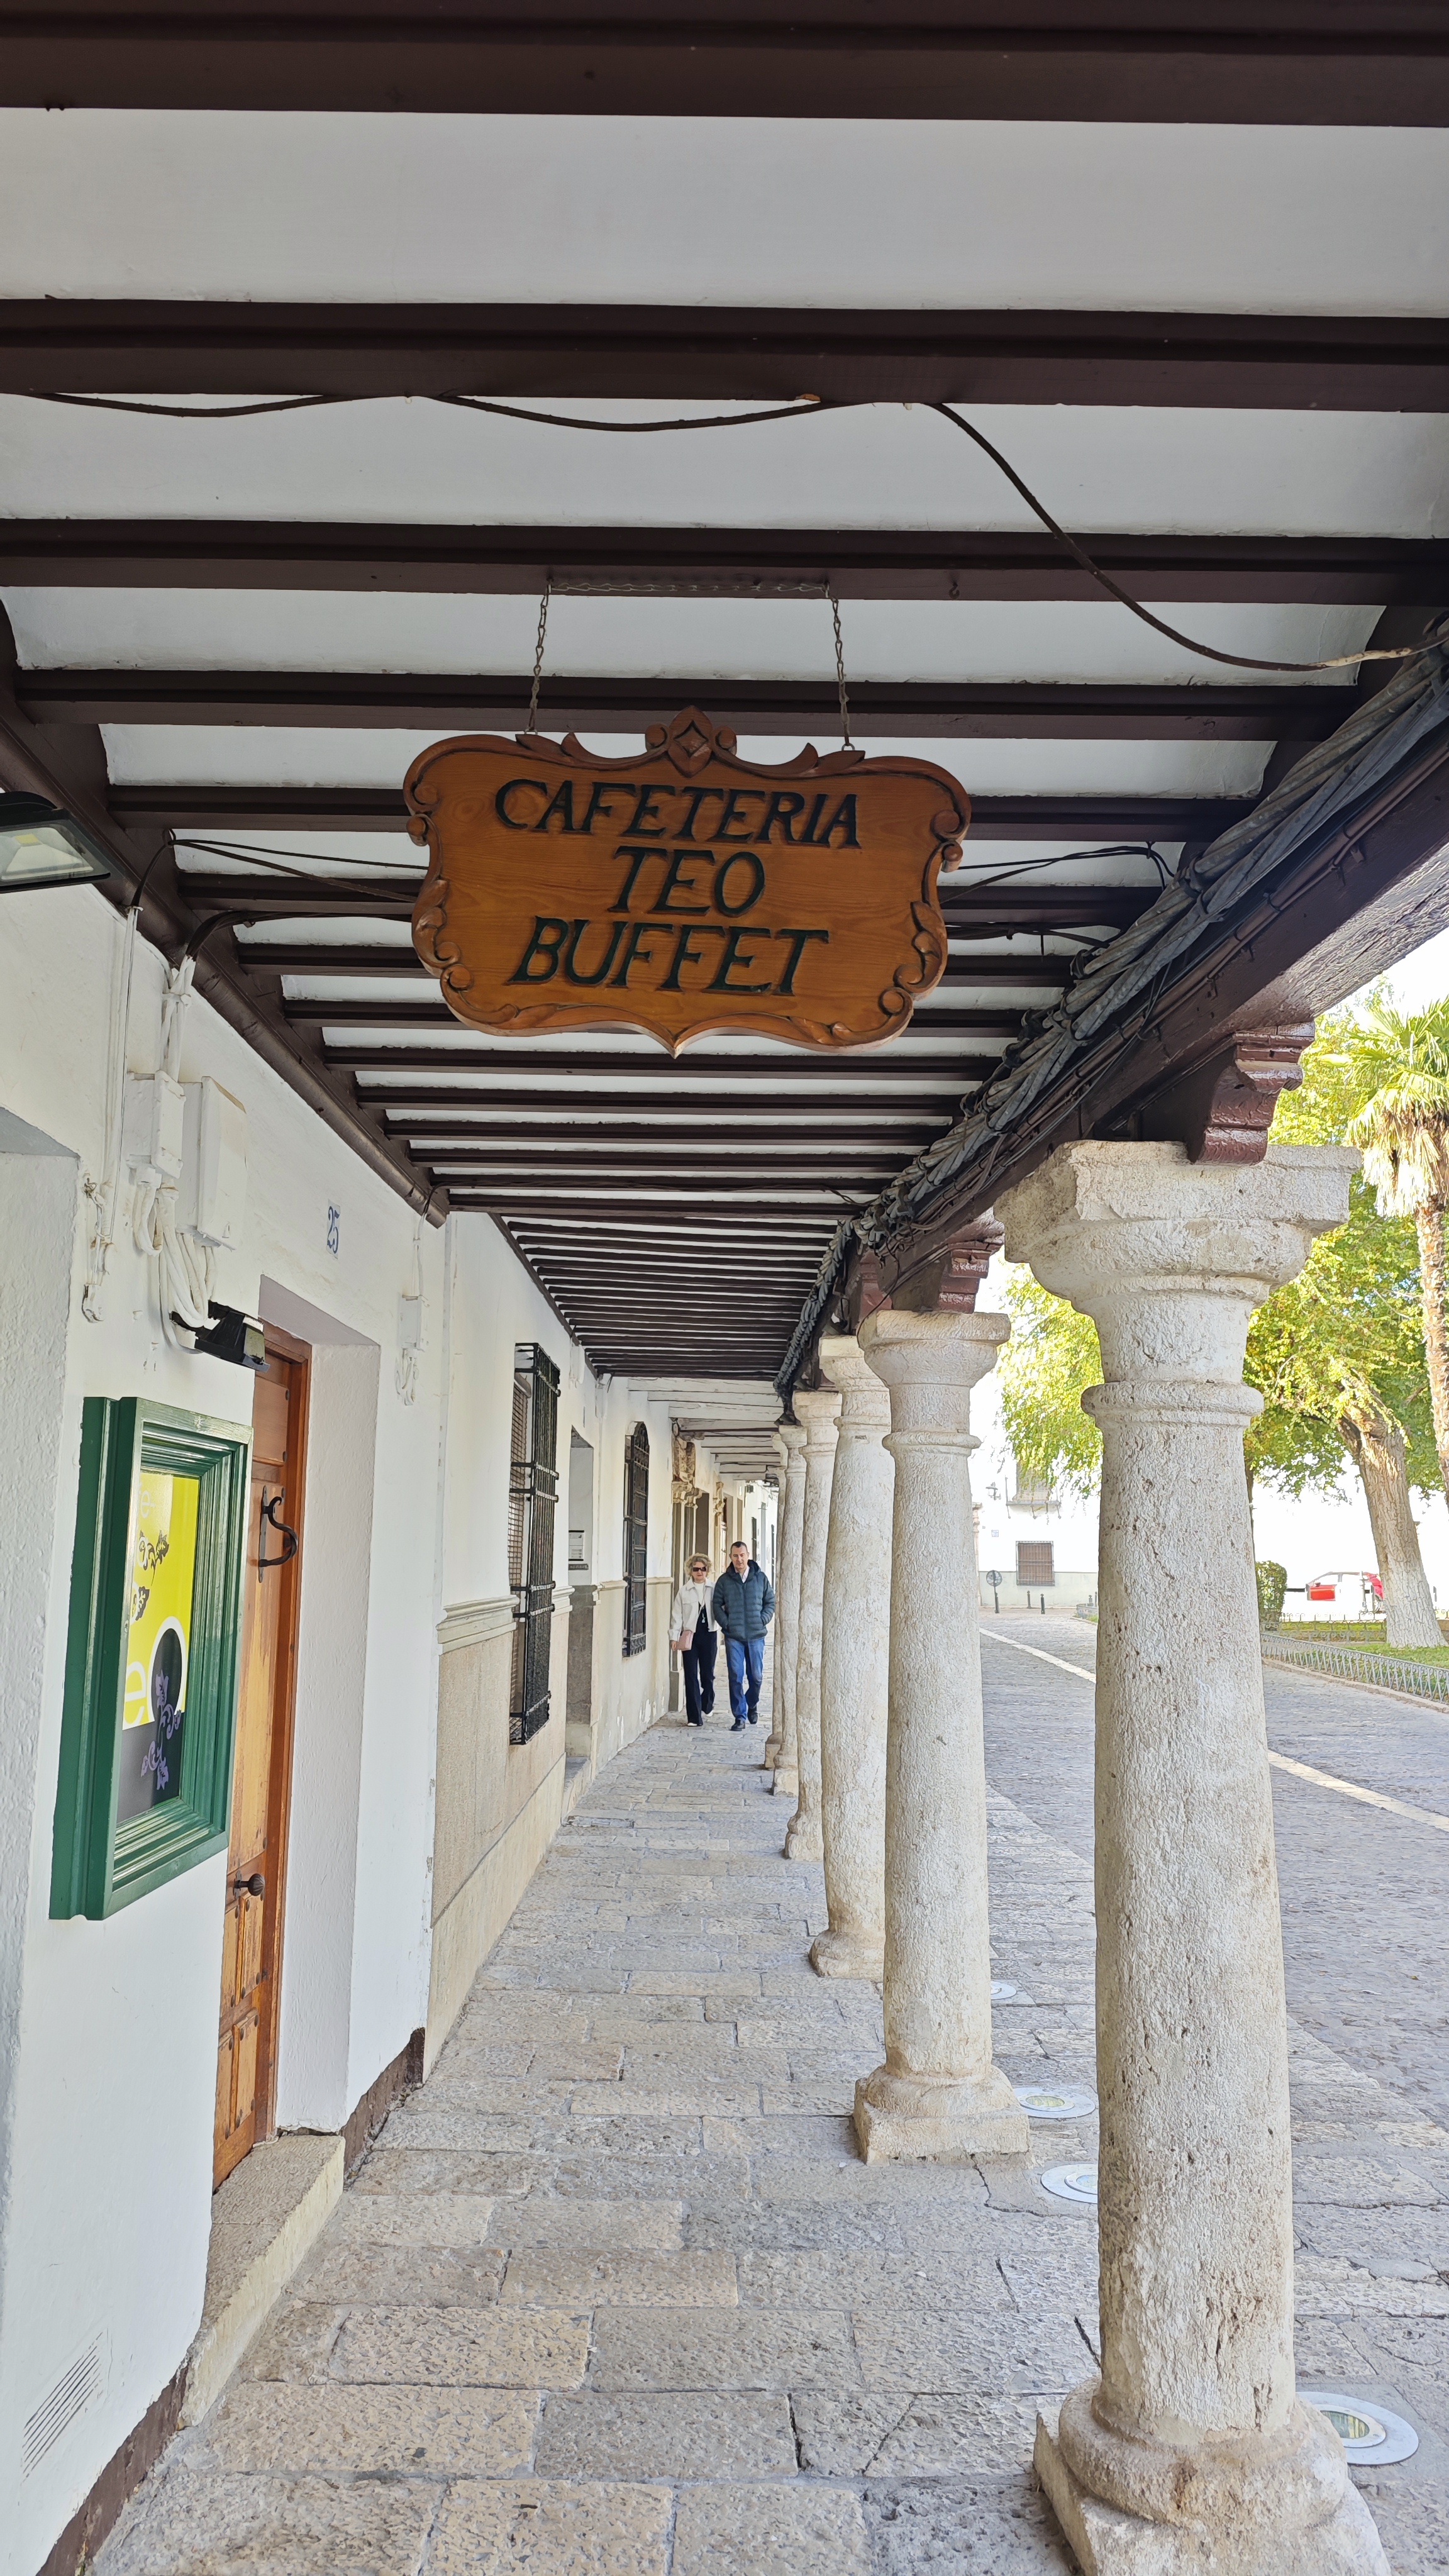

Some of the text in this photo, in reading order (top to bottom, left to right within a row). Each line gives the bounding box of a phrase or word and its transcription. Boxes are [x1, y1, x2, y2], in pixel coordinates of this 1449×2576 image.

[494, 779, 862, 848] CAFETERIA
[608, 845, 766, 918] TEO
[506, 916, 829, 996] BUFFET
[327, 1206, 340, 1254] 25
